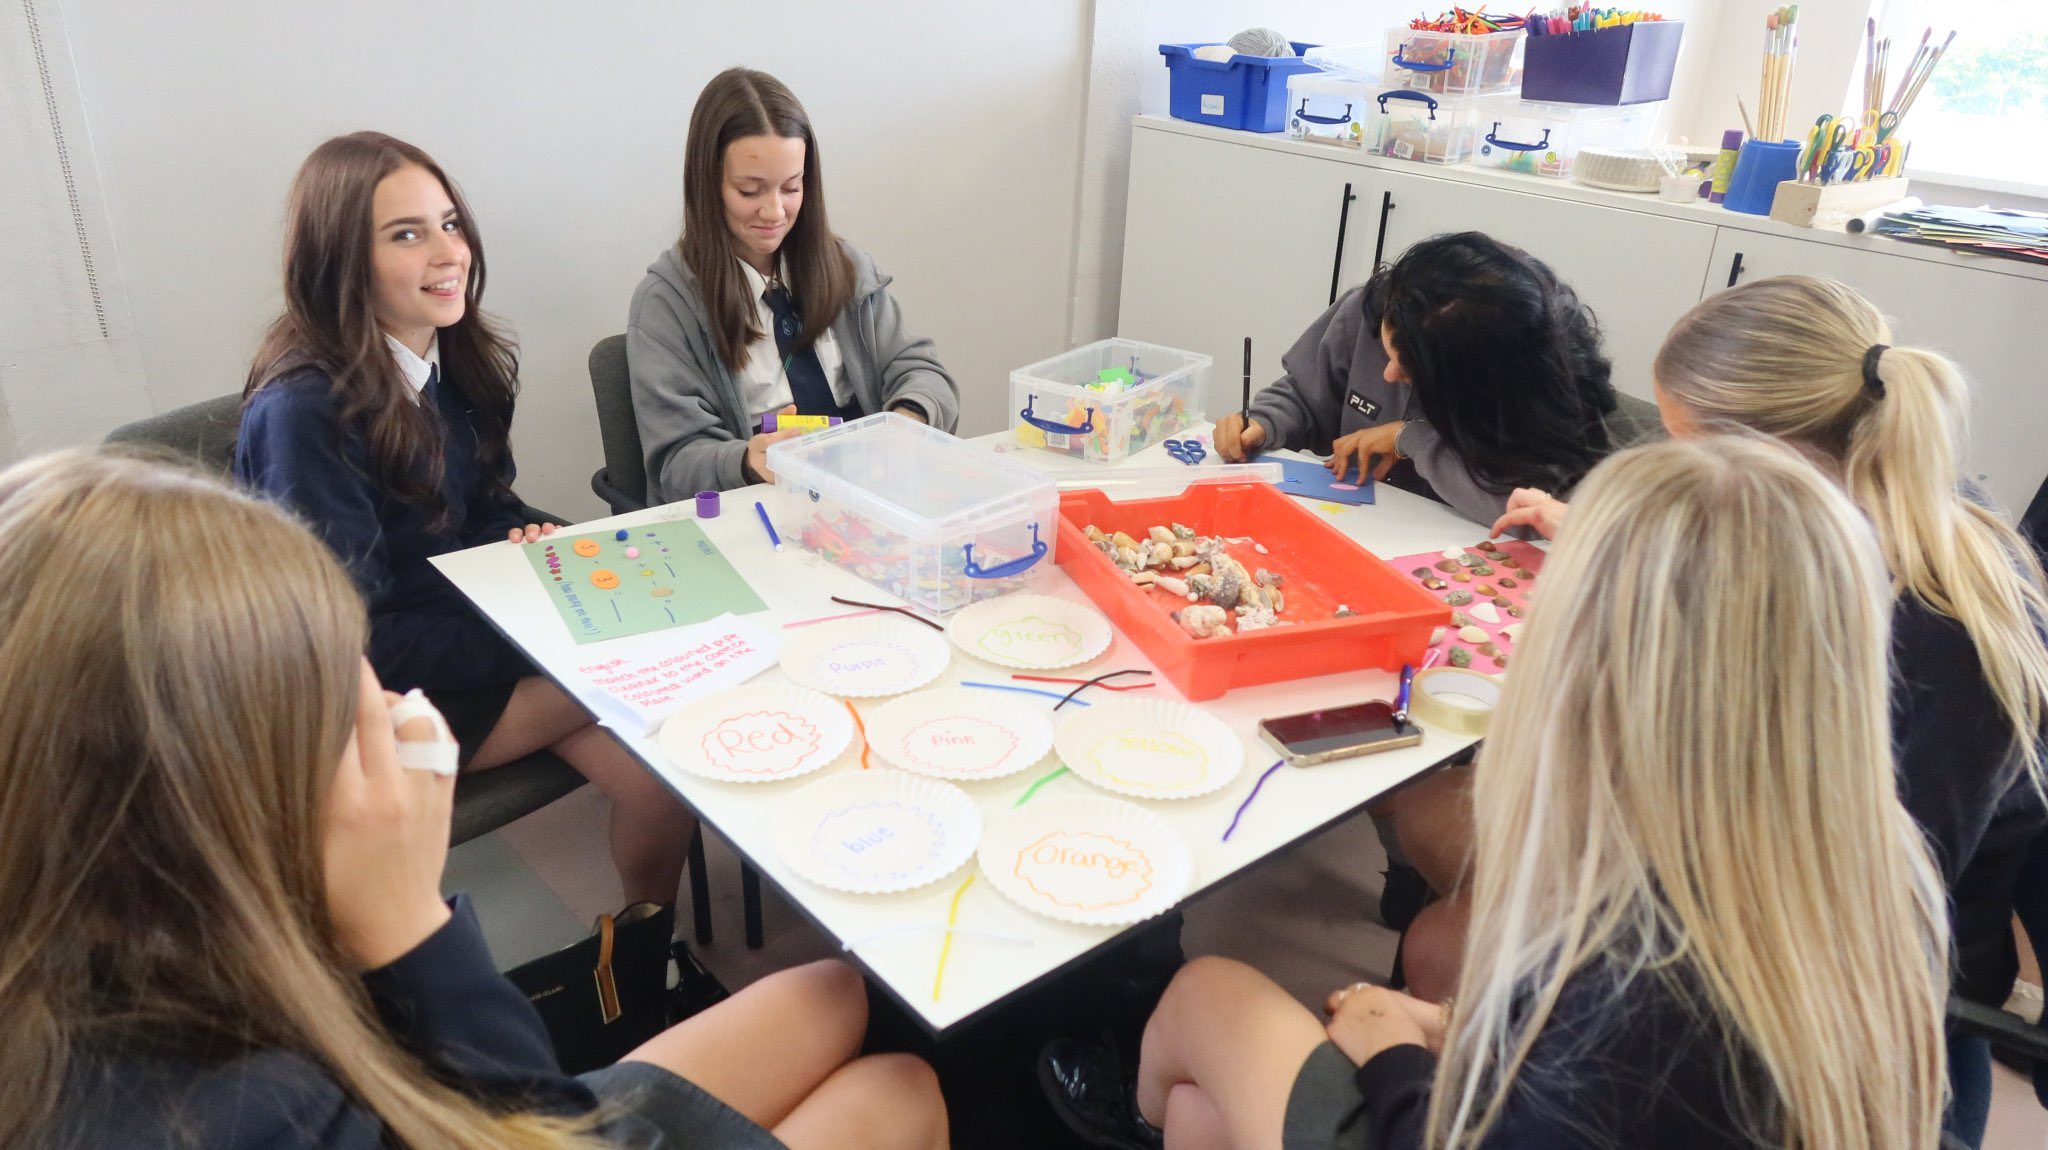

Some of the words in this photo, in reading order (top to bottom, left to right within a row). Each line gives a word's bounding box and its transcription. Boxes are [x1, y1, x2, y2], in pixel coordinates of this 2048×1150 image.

[1350, 394, 1376, 415] PLT
[636, 665, 660, 675] the
[712, 633, 741, 648] pipe
[661, 671, 679, 679] to
[680, 660, 705, 671] the
[680, 667, 713, 684] word
[728, 647, 758, 660] the
[717, 722, 805, 758] Red
[841, 826, 895, 853] blue
[1032, 844, 1139, 879] Orange
